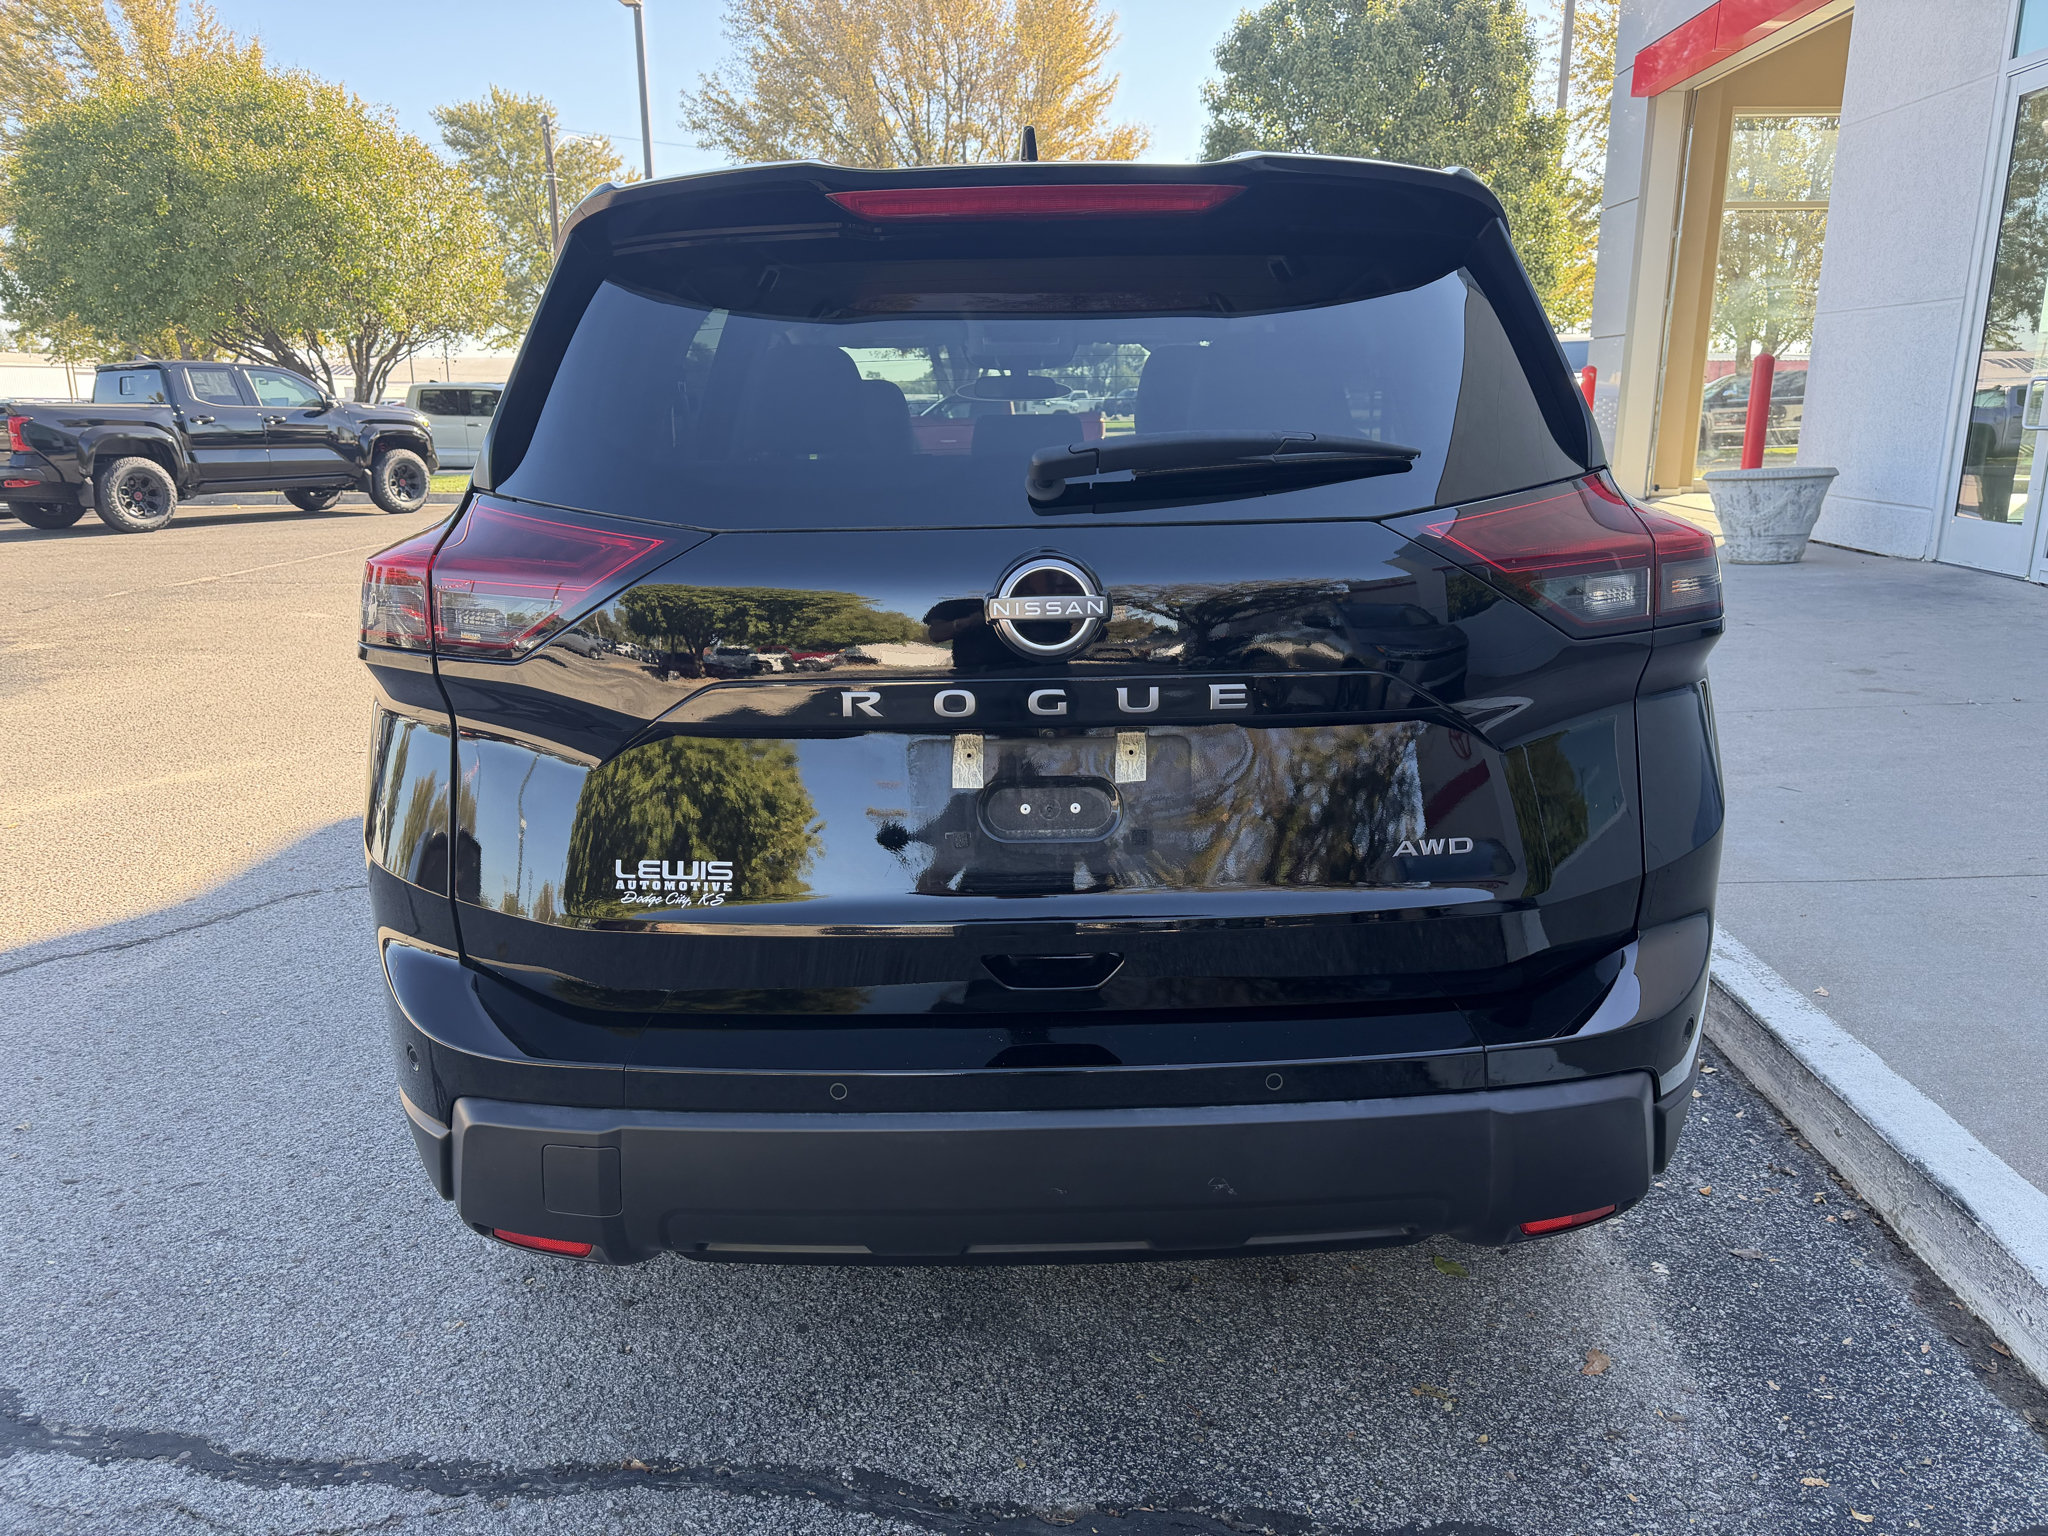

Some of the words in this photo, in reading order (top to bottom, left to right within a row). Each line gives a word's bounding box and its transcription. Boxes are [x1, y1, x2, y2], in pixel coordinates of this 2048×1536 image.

[993, 600, 1105, 616] NISSAN
[841, 683, 1248, 718] ROGUE
[1392, 837, 1474, 857] AWD
[615, 859, 733, 880] LEWIS
[615, 881, 733, 892] AUTOMOTIVE
[621, 892, 663, 906] Dodge
[665, 891, 691, 909] City,
[697, 892, 726, 906] KS
